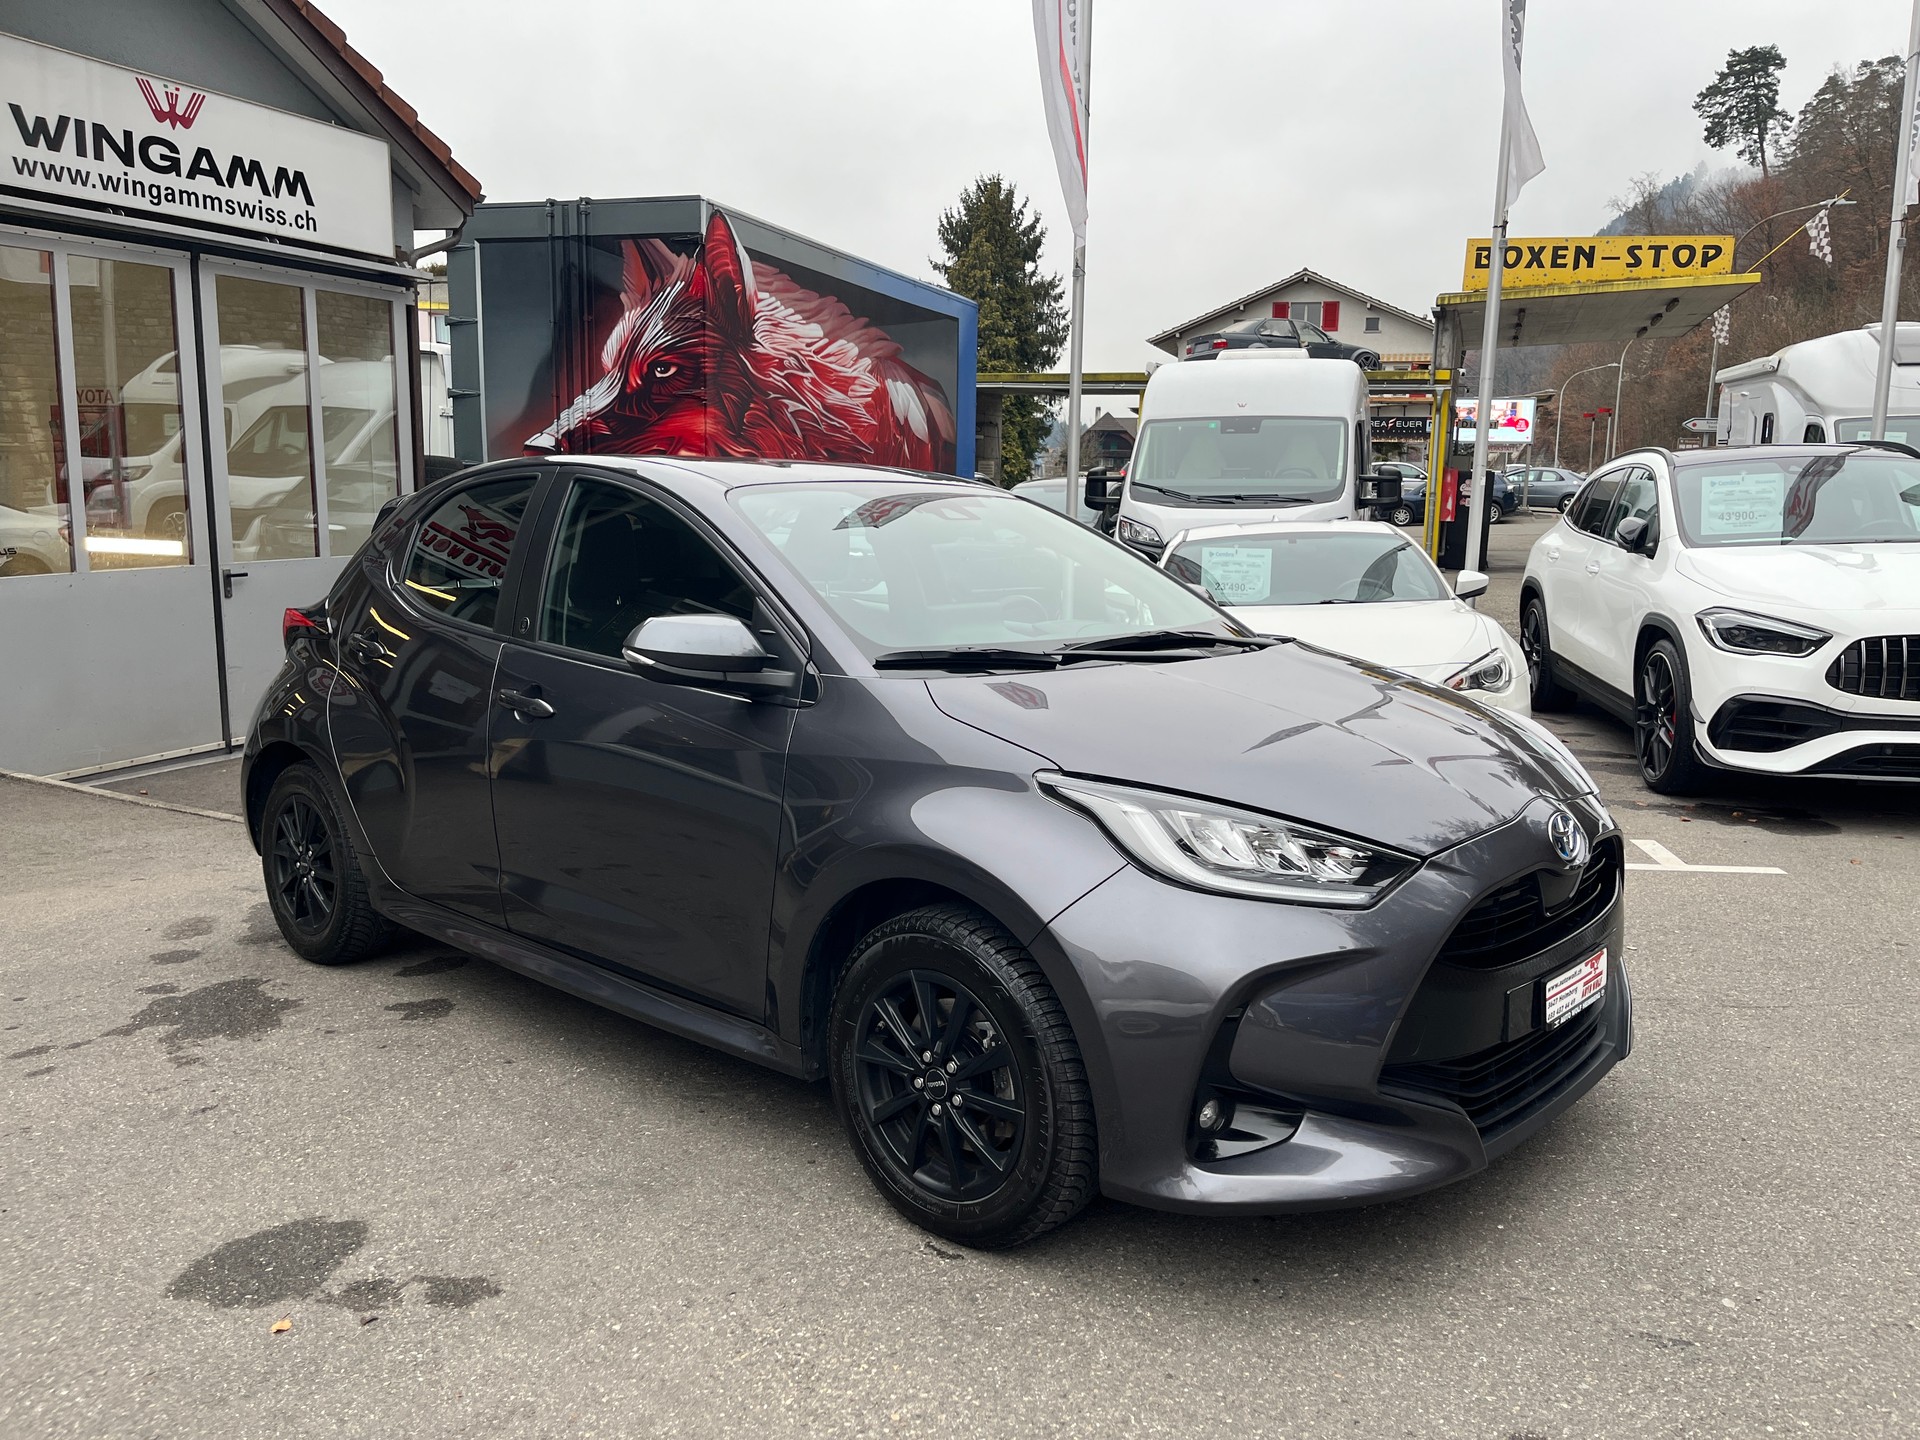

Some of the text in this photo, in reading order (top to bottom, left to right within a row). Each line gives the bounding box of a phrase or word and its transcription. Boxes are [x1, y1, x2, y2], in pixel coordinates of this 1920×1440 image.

[8, 102, 316, 207] WINGAMM
[12, 155, 318, 233] www.wingammswiss.ch
[77, 389, 115, 404] YOTA
[927, 1080, 945, 1088] TOYOTA
